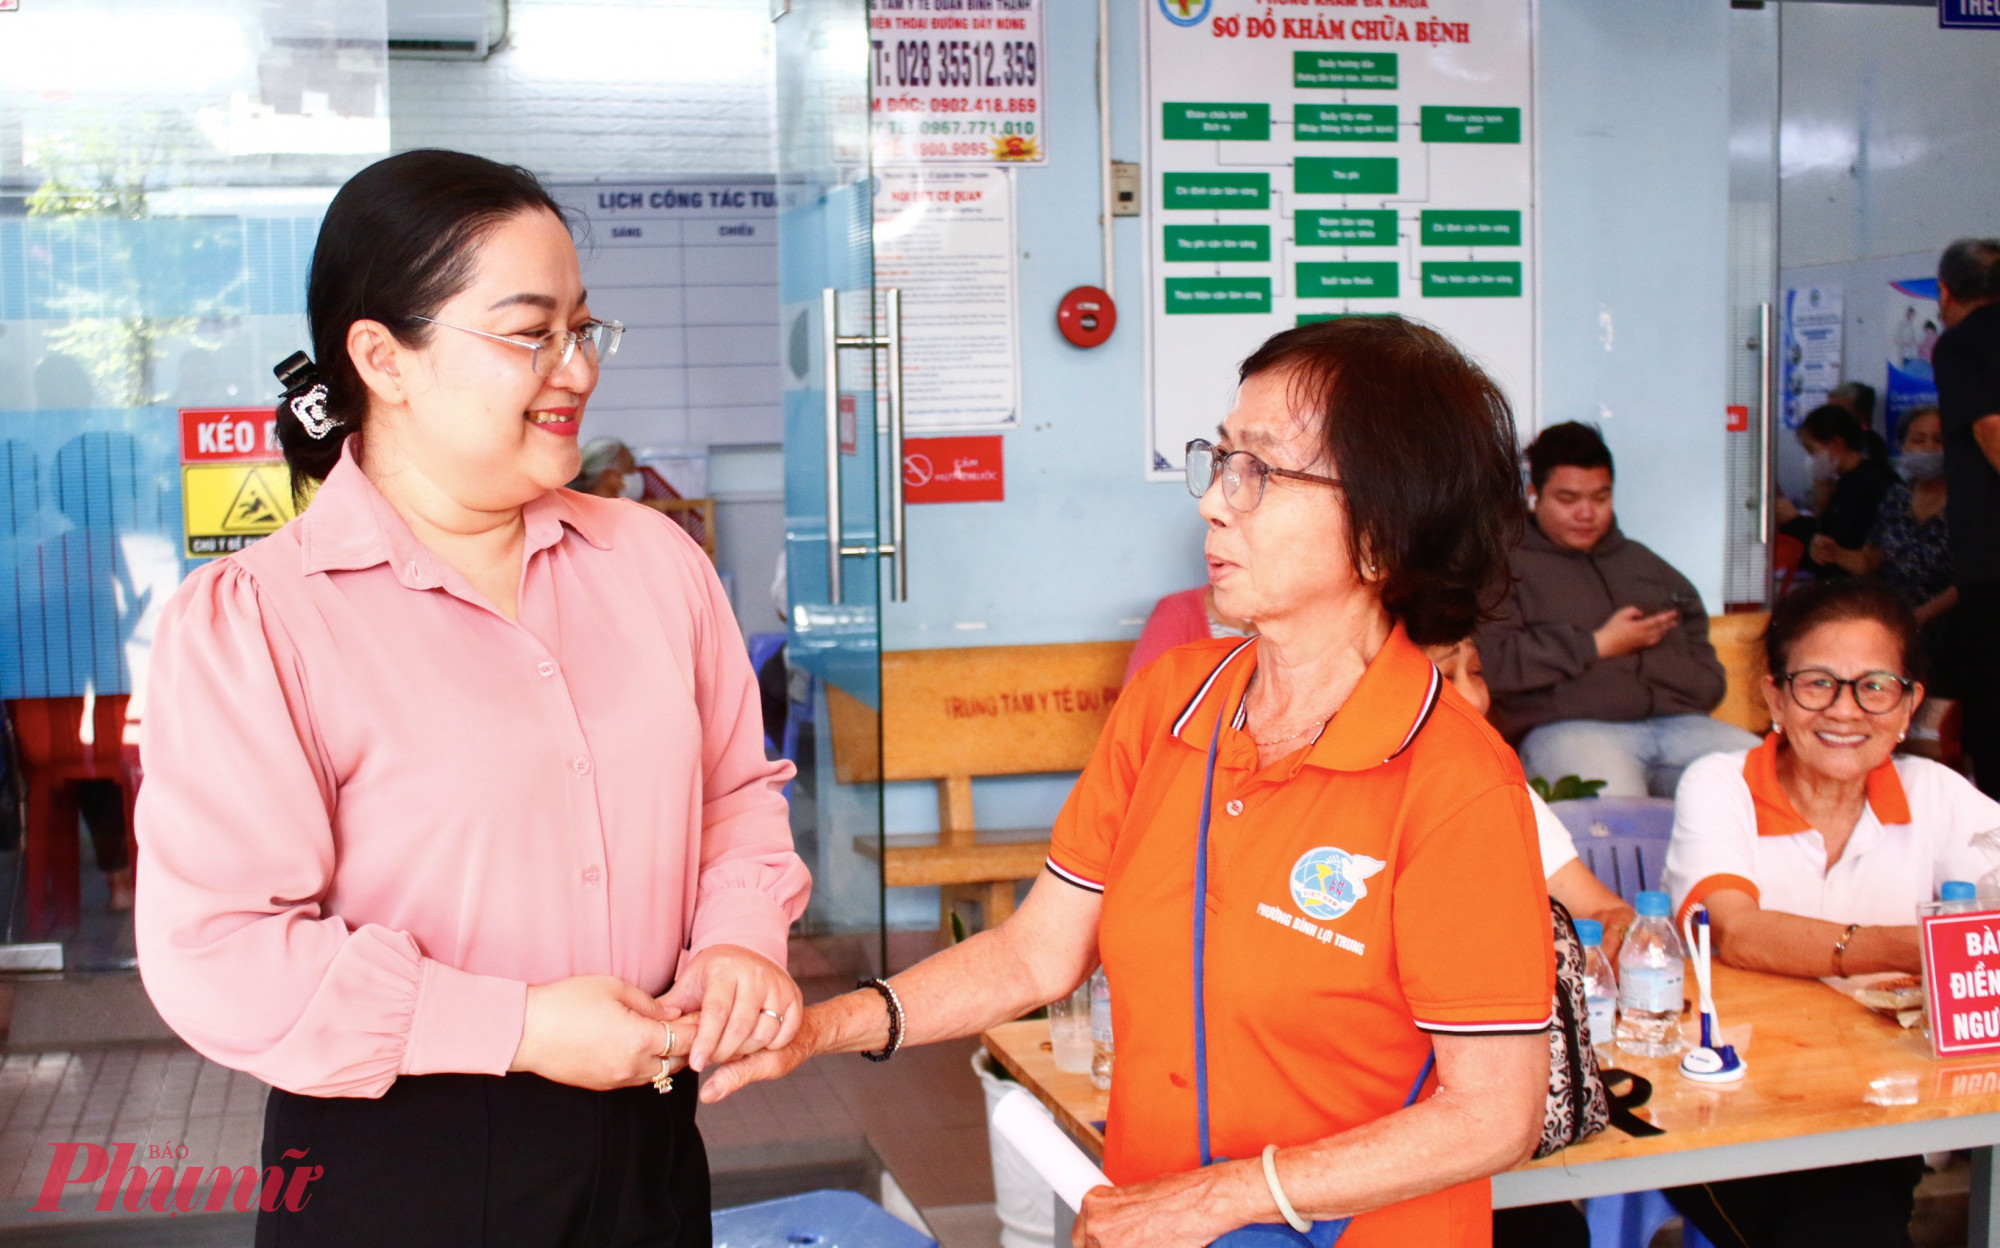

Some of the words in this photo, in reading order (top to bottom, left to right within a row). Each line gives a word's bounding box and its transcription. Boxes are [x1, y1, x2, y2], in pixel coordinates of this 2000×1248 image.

[896, 40, 931, 87] 028
[938, 40, 1037, 87] 35512.359
[930, 97, 1036, 113] 0902.418.869
[920, 121, 1034, 135] 0967.771.010
[600, 193, 643, 213] LỊCH
[650, 189, 703, 209] CÔNG
[710, 189, 746, 207] TÁC
[197, 415, 255, 453] KÉO
[1292, 917, 1318, 937] BÌNH
[1316, 927, 1334, 945] LỢI
[1334, 934, 1365, 955] TRUNG
[1966, 925, 2000, 957] BÀ
